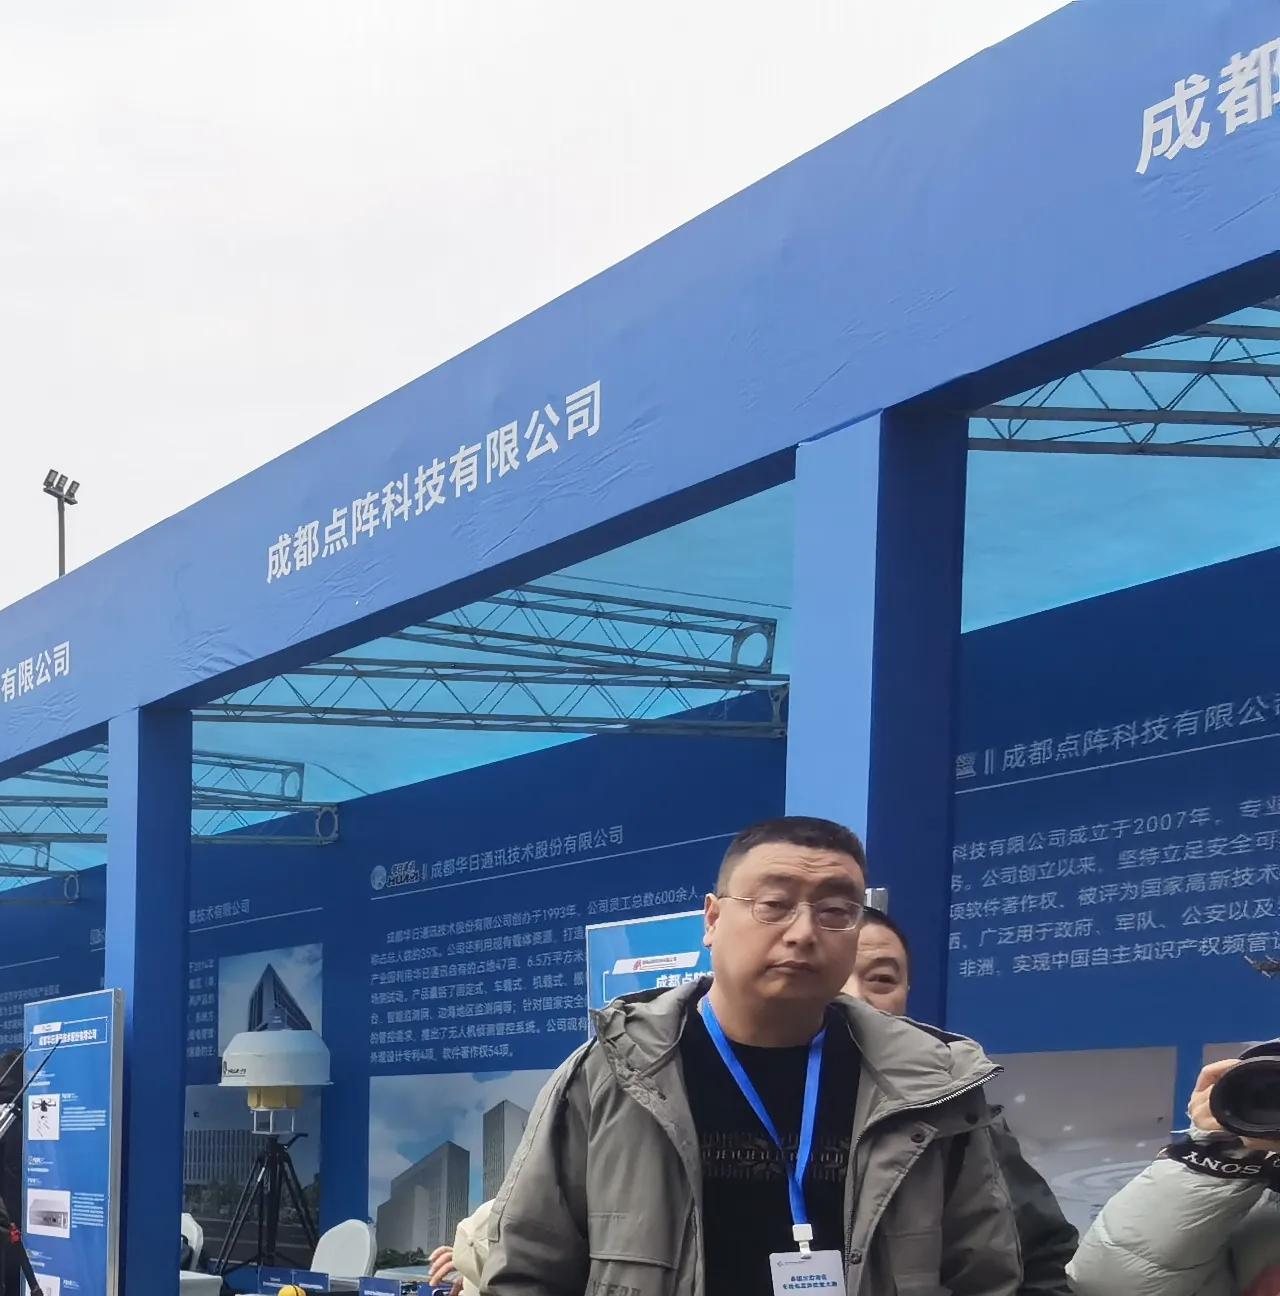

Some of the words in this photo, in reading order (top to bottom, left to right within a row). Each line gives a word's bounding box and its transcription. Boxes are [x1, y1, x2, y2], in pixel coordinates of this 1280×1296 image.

[1135, 37, 1280, 175] 成都
[266, 379, 602, 585] 成都点阵科技有限公司
[430, 824, 624, 880] 成都华日通讯技术股份有限公司
[1181, 1151, 1262, 1175] SONY
